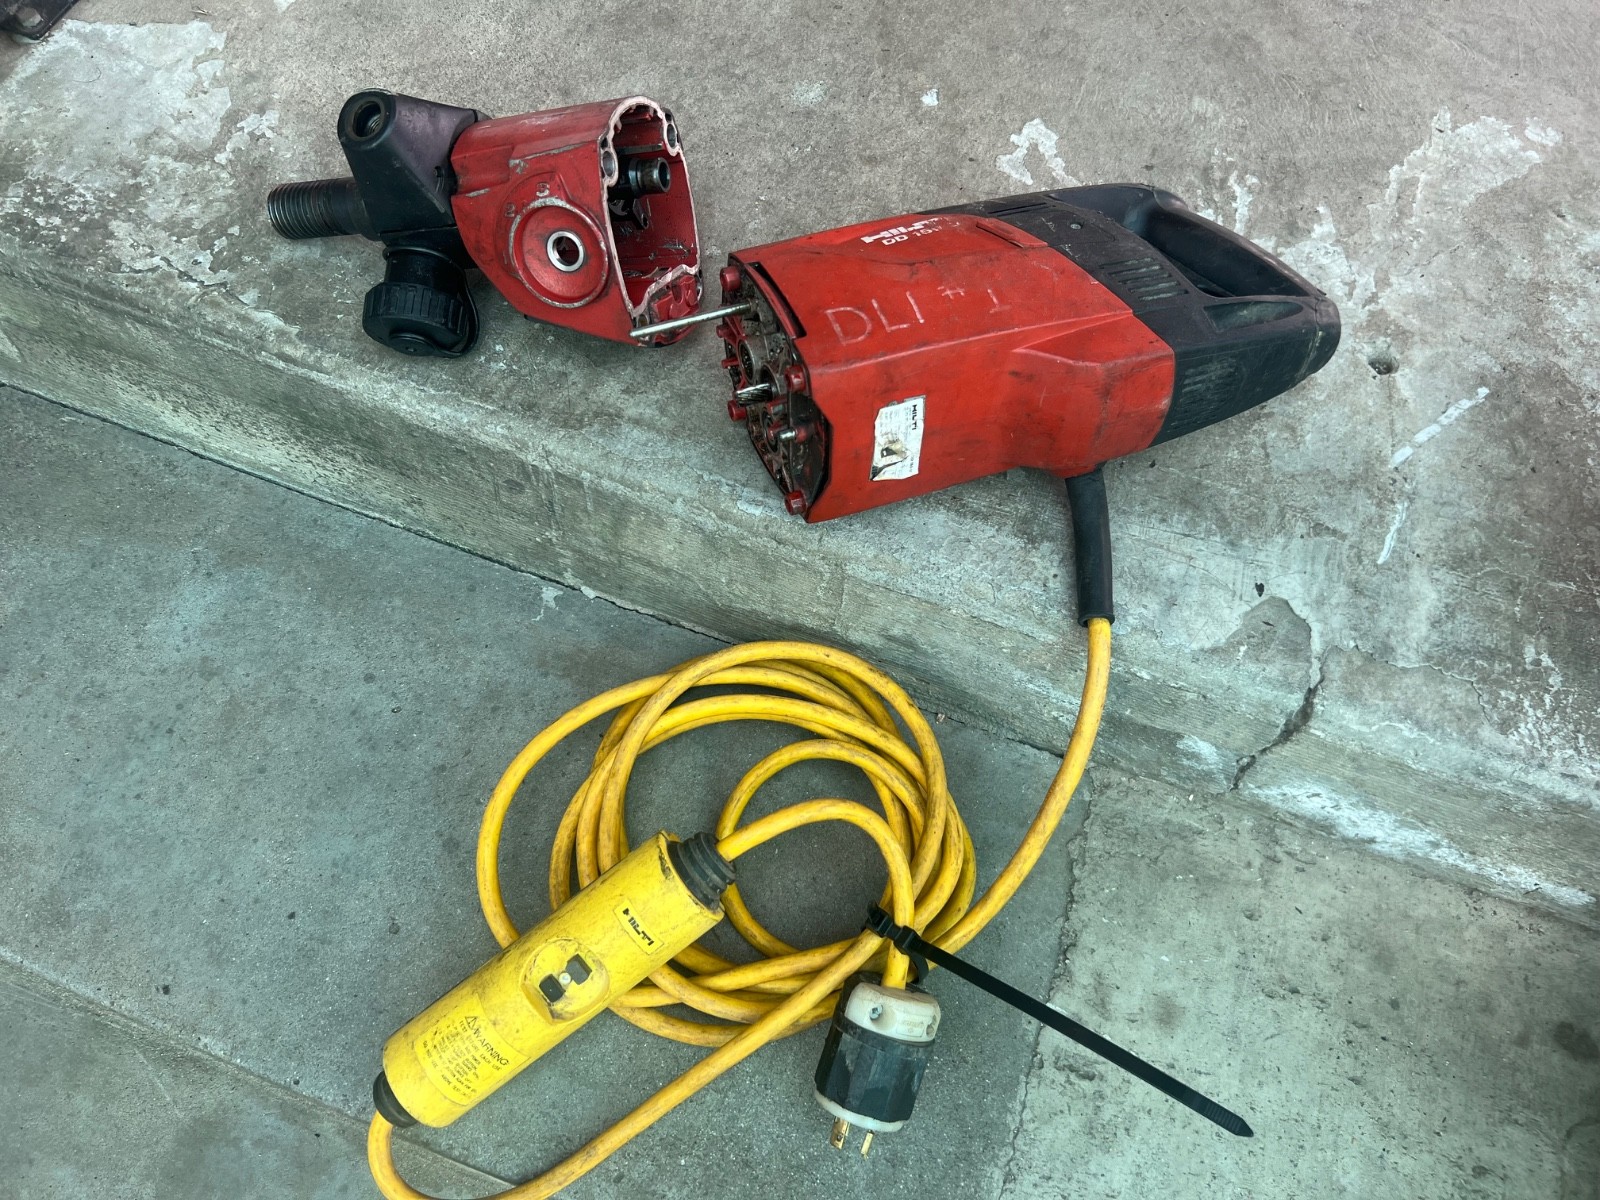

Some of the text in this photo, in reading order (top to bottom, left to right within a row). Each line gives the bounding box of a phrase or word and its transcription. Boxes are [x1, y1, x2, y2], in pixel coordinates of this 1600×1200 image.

[881, 234, 909, 245] DD
[622, 907, 655, 946] HILTI
[474, 1028, 509, 1065] WARNING
